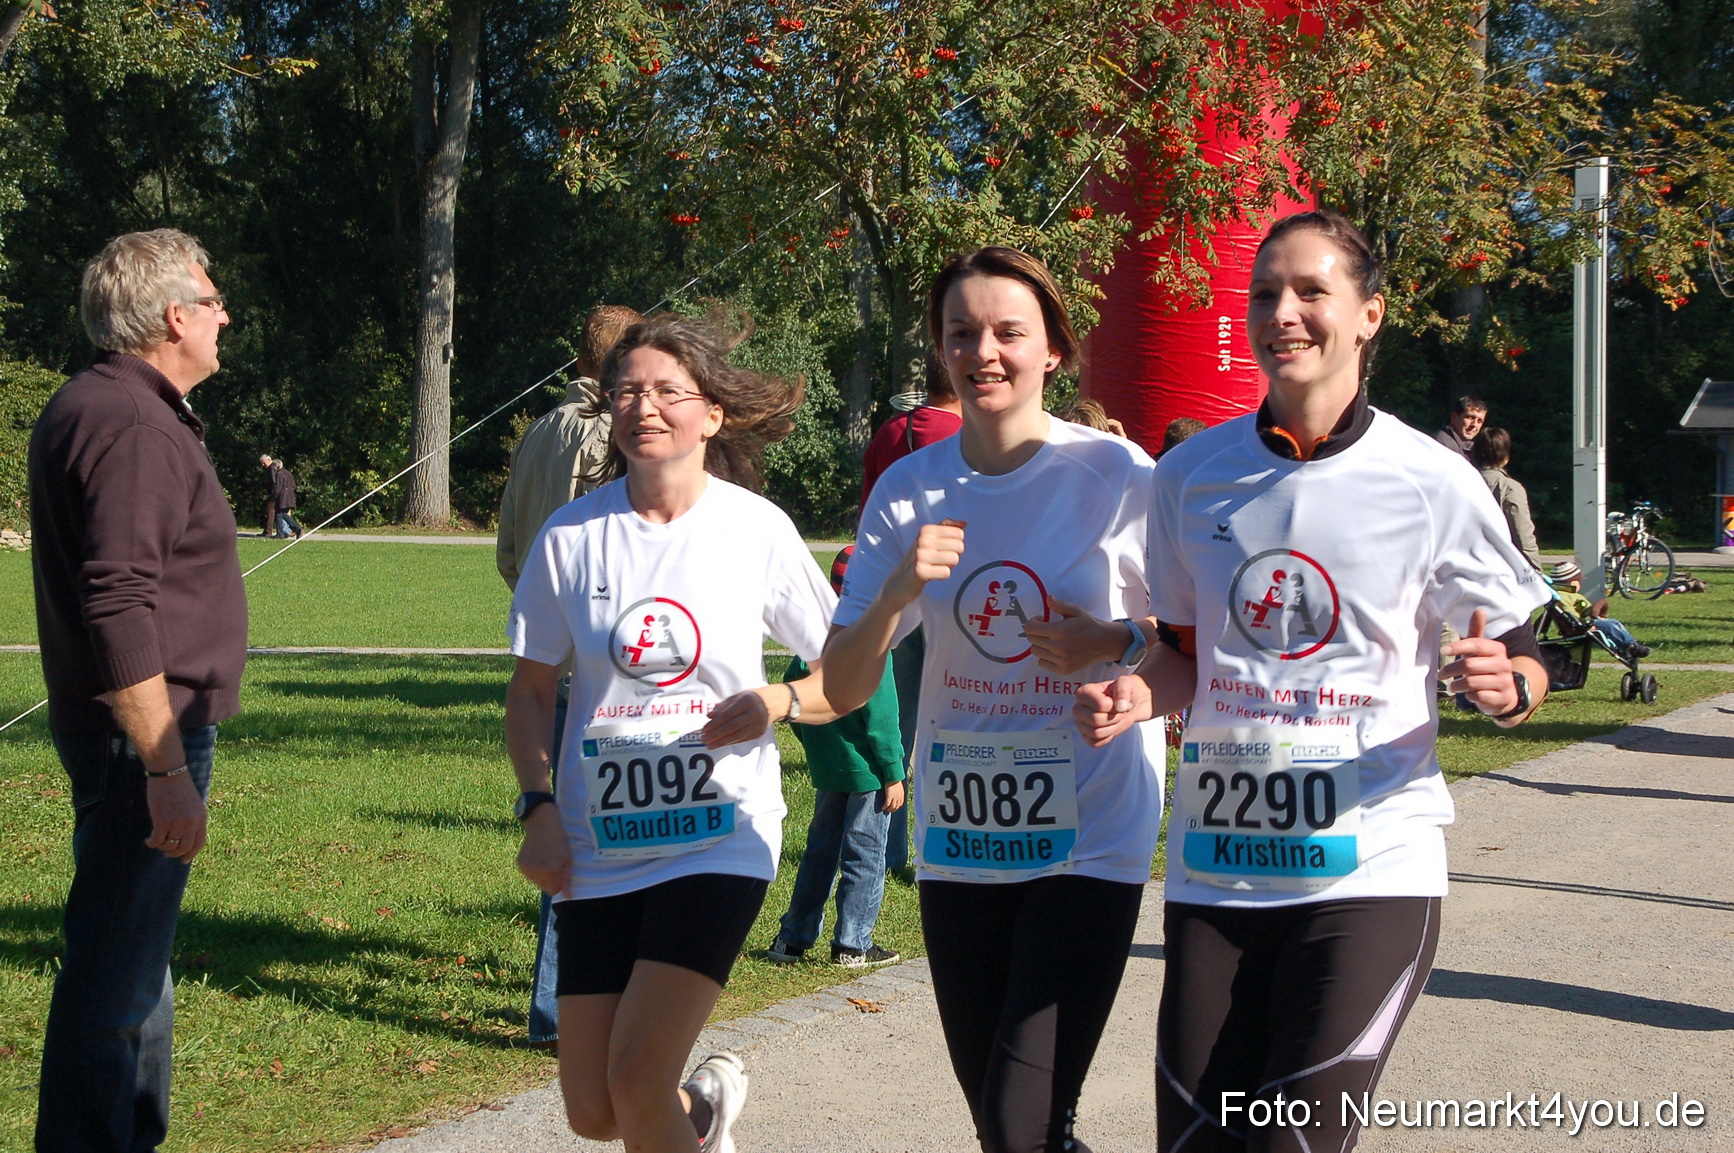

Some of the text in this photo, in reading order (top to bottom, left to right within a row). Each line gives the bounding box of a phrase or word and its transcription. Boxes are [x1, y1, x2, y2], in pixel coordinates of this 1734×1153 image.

[1218, 316, 1232, 371] Seit 1929
[996, 681, 1026, 695] MIT
[1034, 676, 1083, 695] HERZ
[1208, 677, 1372, 706] AUFEN MIT HERZ
[591, 699, 719, 719] AUFEN MIT HE
[952, 699, 966, 711] Dr.
[1001, 704, 1018, 714] Dr.
[1021, 703, 1064, 716] Röschl
[1215, 701, 1233, 714] Dr.
[1236, 705, 1268, 721] Heck
[1304, 714, 1351, 727] Röschl
[598, 732, 663, 749] PFLEIDERER
[1014, 747, 1059, 759] BOCK
[1200, 742, 1272, 757] PFLEIDERER
[1292, 745, 1341, 757] BOCK
[598, 753, 718, 811] 2092
[938, 769, 1056, 827] 3082
[1198, 770, 1336, 830] 2290
[602, 806, 722, 841] Claudia B
[946, 829, 1053, 862] Stefanie
[1213, 835, 1326, 868] Kristina
